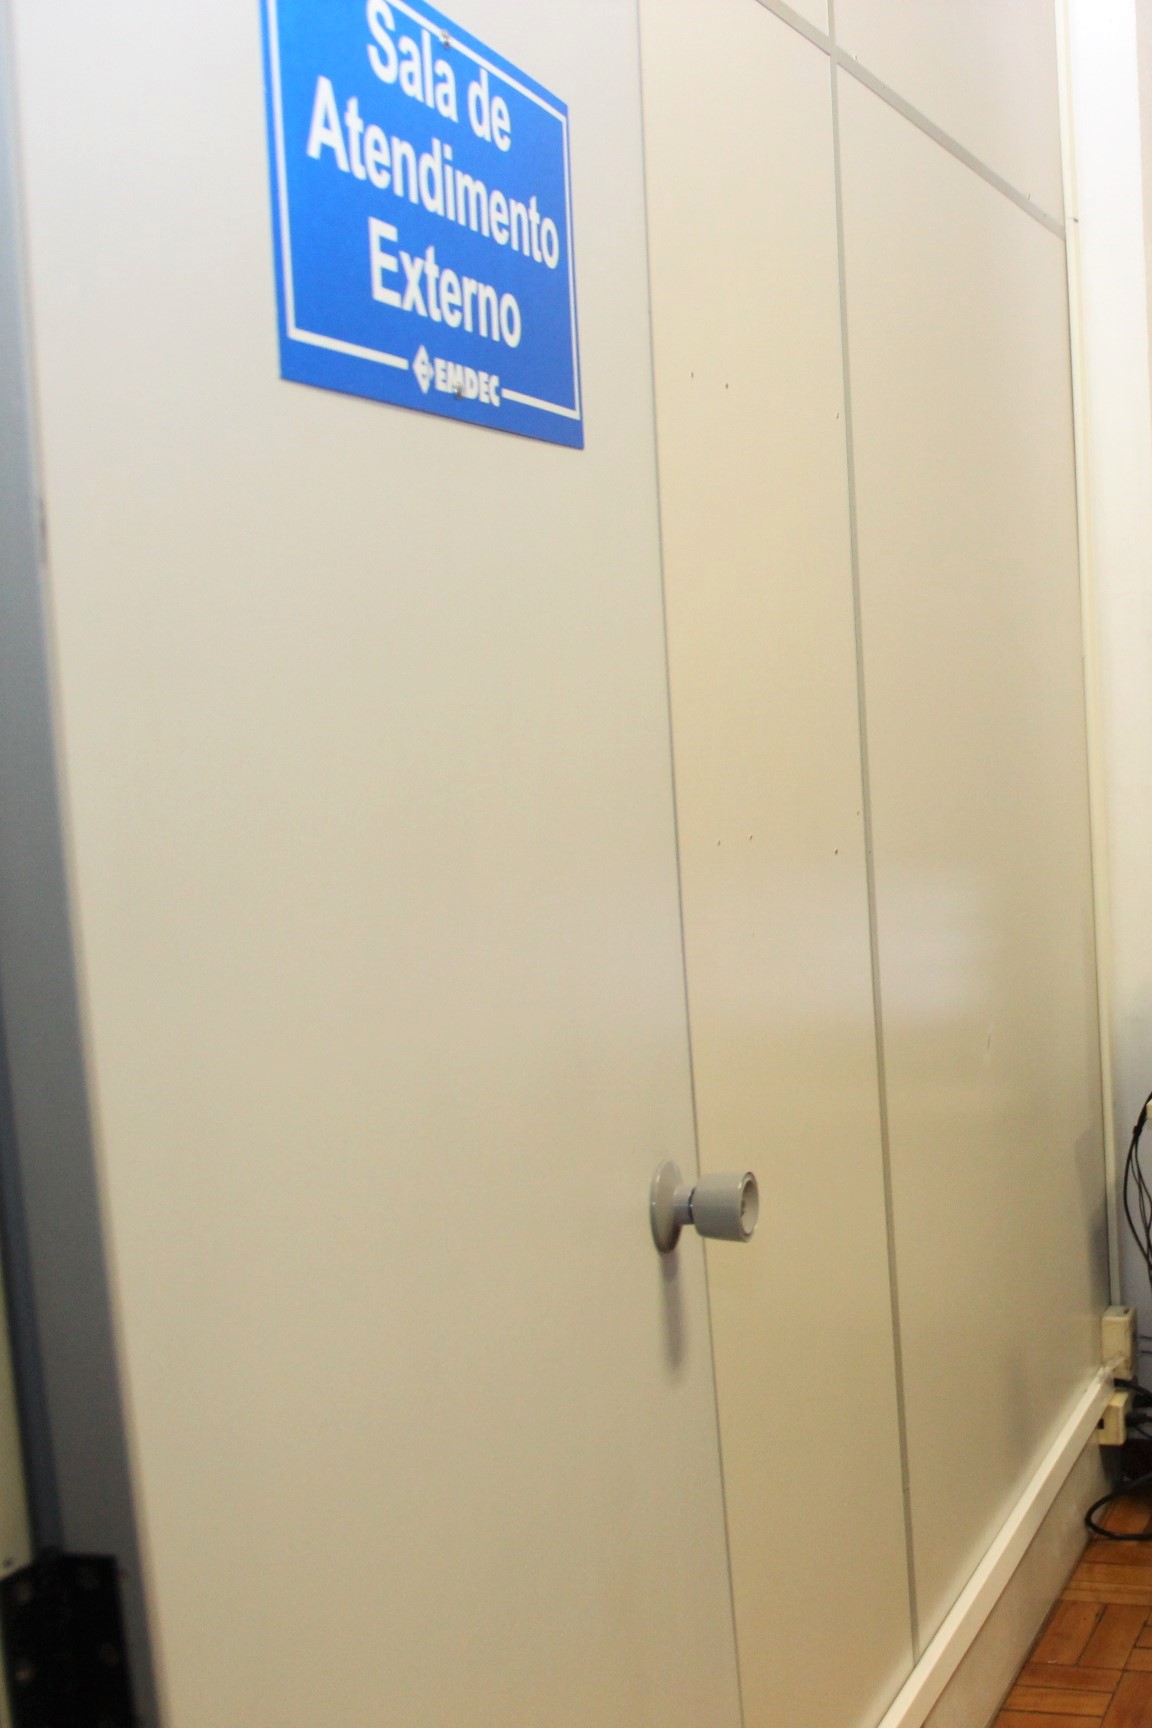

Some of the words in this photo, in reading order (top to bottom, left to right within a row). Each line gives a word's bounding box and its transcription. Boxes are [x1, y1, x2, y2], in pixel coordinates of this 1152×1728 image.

[367, 0, 459, 122] Sala
[467, 68, 511, 152] de
[307, 75, 560, 269] Atendimento
[368, 216, 522, 348] Externo
[434, 358, 500, 407] EMDEC
